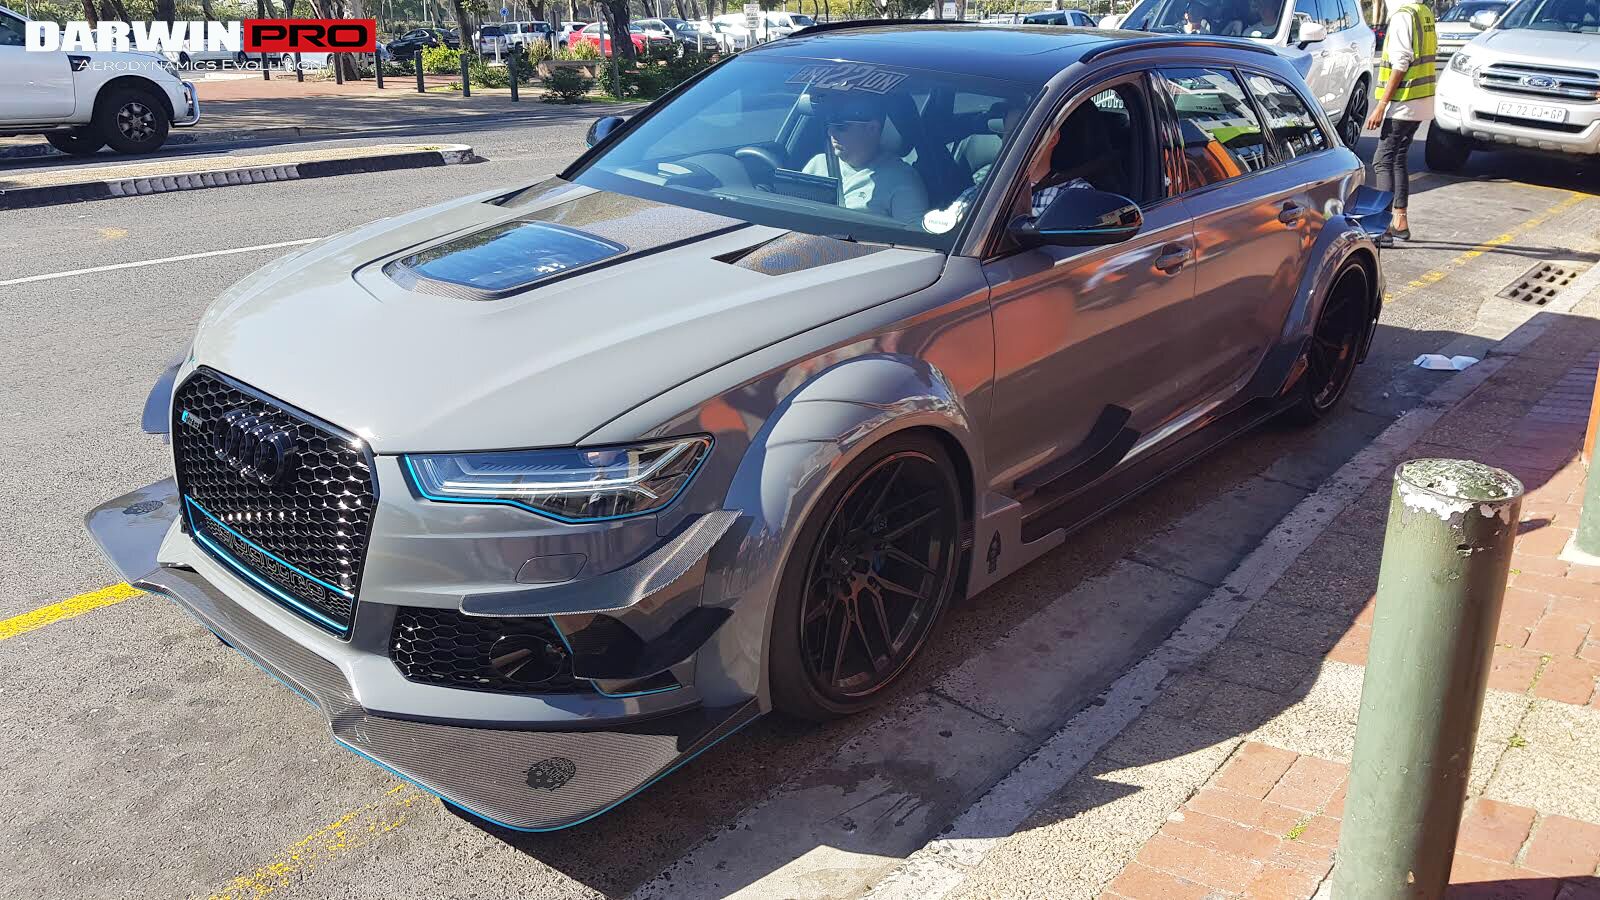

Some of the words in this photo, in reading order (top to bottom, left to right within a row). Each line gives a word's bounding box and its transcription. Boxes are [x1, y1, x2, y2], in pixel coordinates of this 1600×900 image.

[1517, 105, 1528, 116] 72
[1551, 109, 1563, 120] GP
[219, 525, 327, 601] quattro
